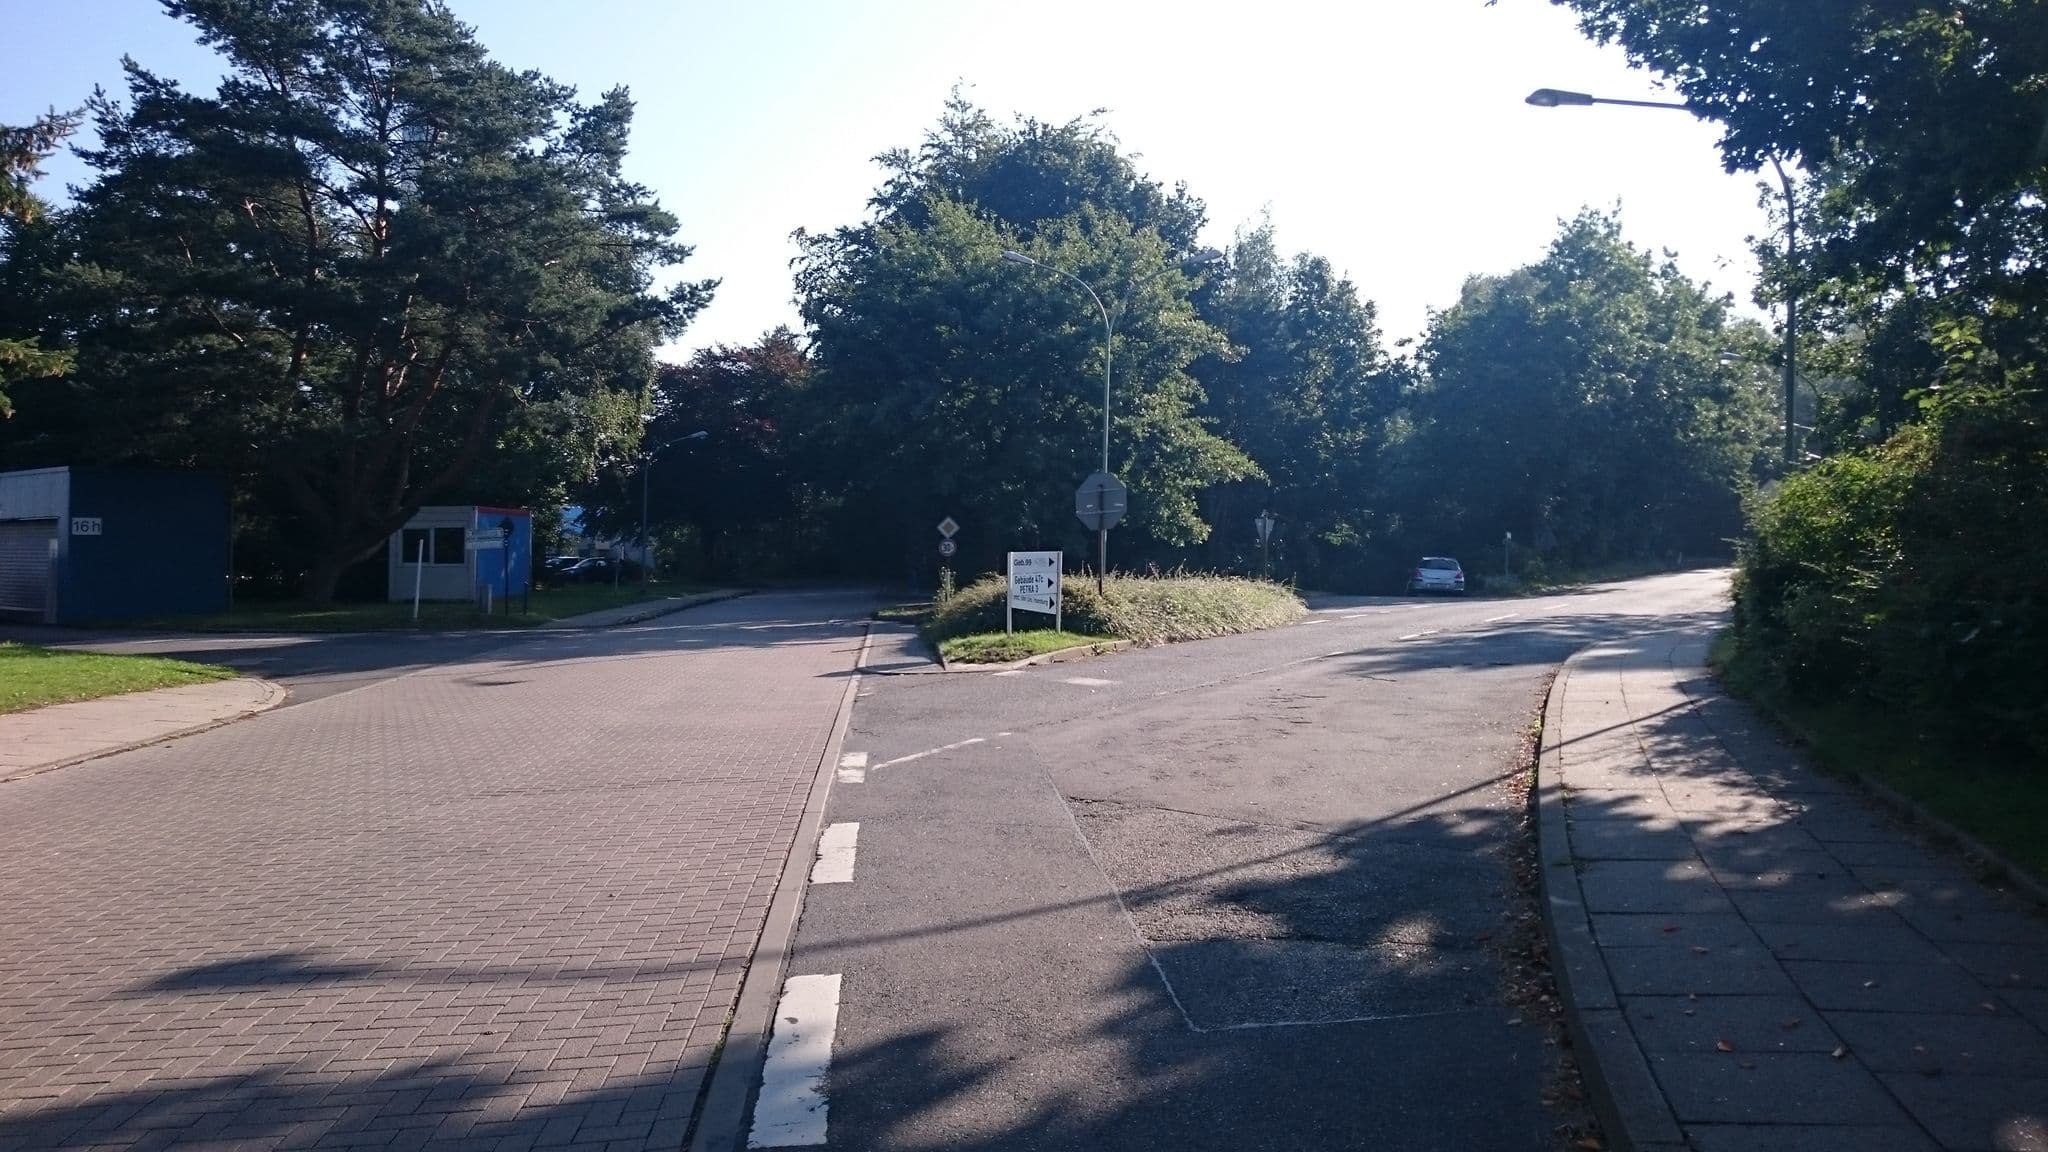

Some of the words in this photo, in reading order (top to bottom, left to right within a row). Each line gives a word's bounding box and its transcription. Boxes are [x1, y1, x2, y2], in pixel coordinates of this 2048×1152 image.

[73, 520, 89, 532] 16
[92, 520, 101, 532] h
[1020, 585, 1034, 594] PETRA
